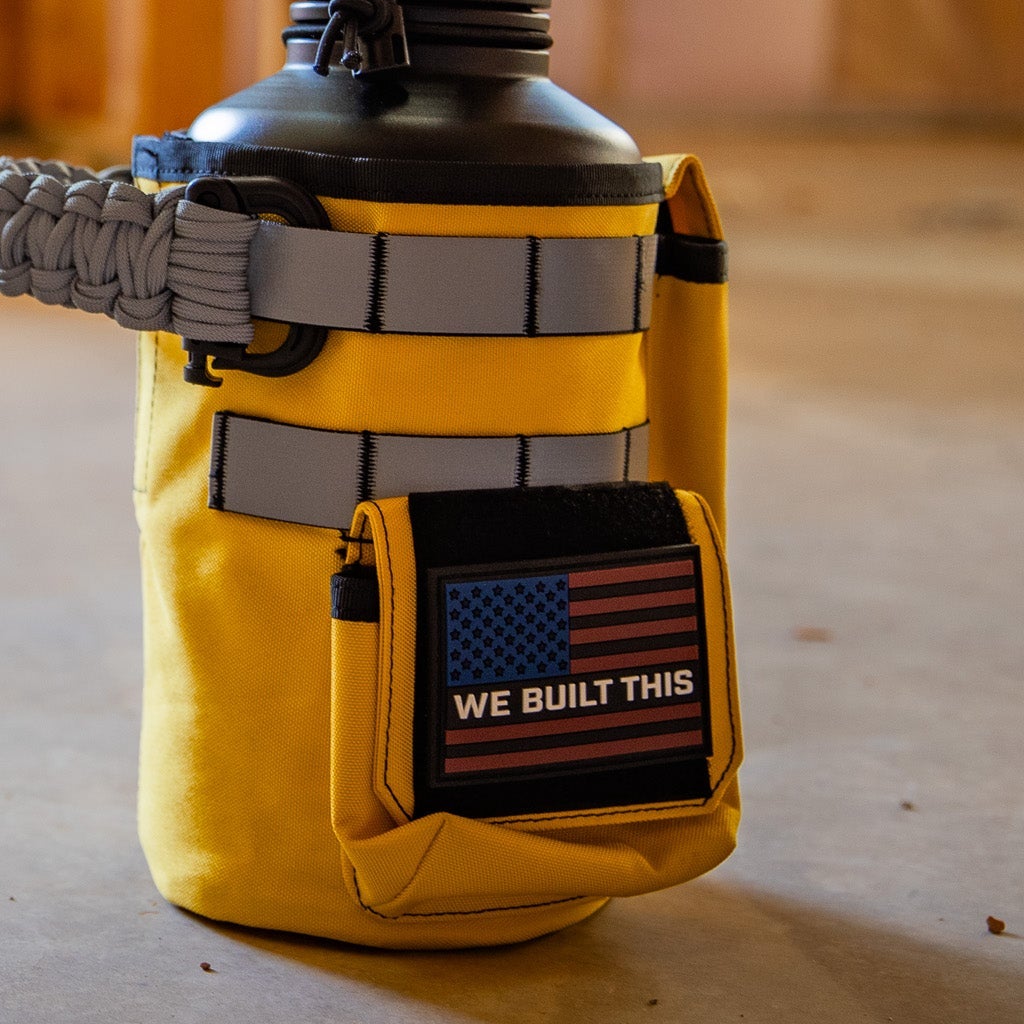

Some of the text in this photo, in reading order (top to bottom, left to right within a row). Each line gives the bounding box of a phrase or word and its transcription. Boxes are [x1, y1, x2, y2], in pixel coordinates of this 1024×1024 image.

[453, 669, 694, 720] WE BUILT THIS
